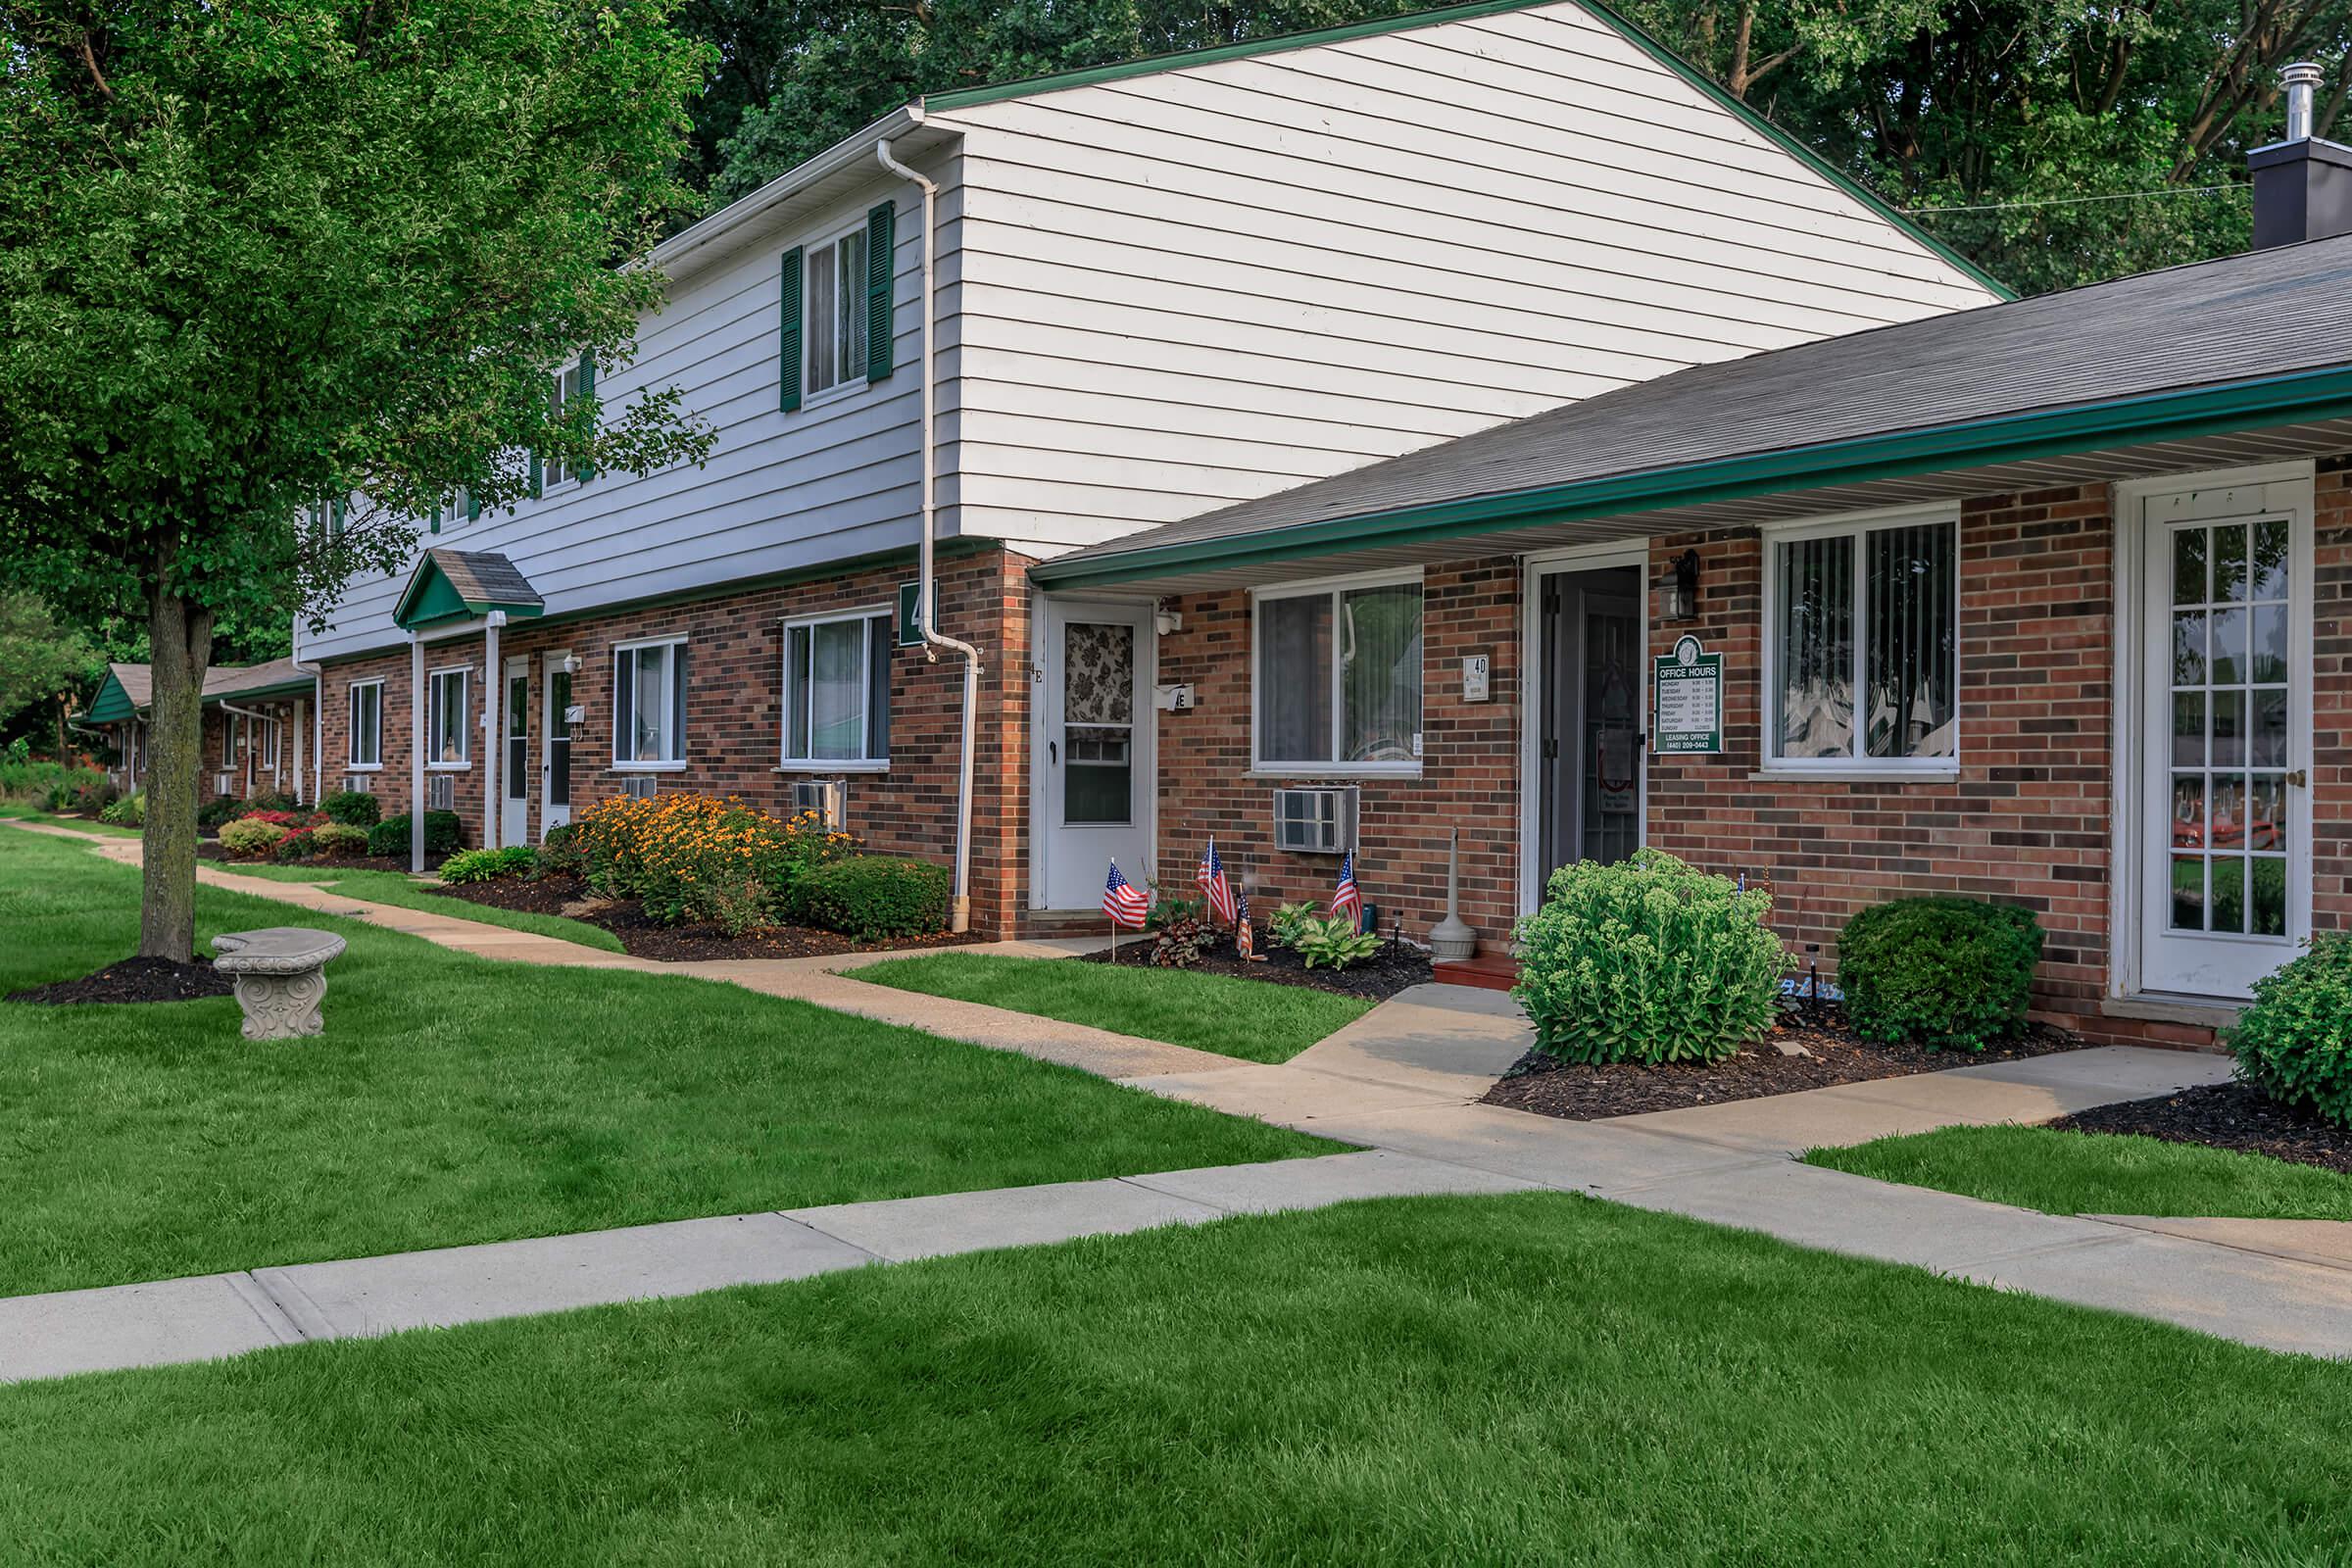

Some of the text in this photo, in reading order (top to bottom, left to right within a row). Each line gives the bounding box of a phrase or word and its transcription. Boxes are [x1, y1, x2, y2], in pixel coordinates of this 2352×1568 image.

[1475, 659, 1485, 673] 40
[1660, 667, 1716, 679] OFFICE HOURS
